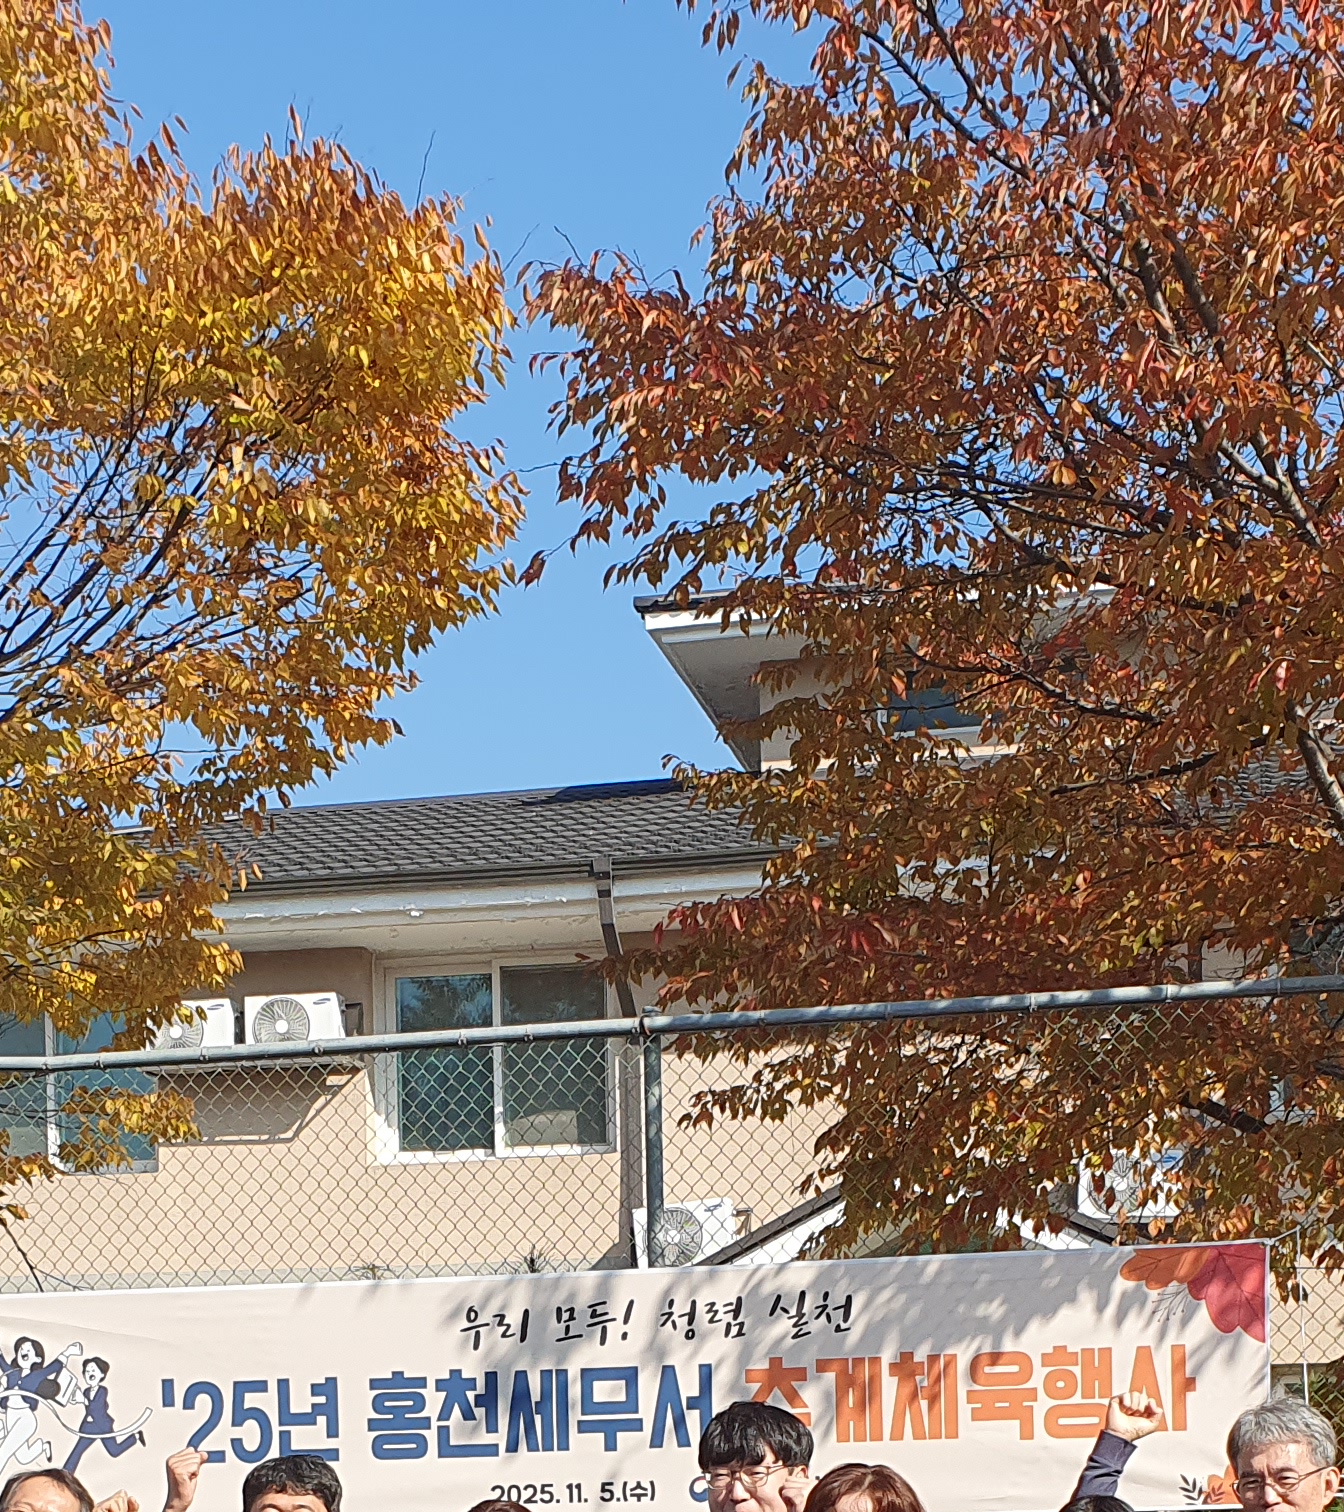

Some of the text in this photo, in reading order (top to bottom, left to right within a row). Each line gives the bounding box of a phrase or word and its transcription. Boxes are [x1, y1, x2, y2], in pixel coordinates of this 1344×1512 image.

[459, 1289, 854, 1351] 우리 모두! 청렴 실천
[367, 1363, 714, 1460] 홍천세무서
